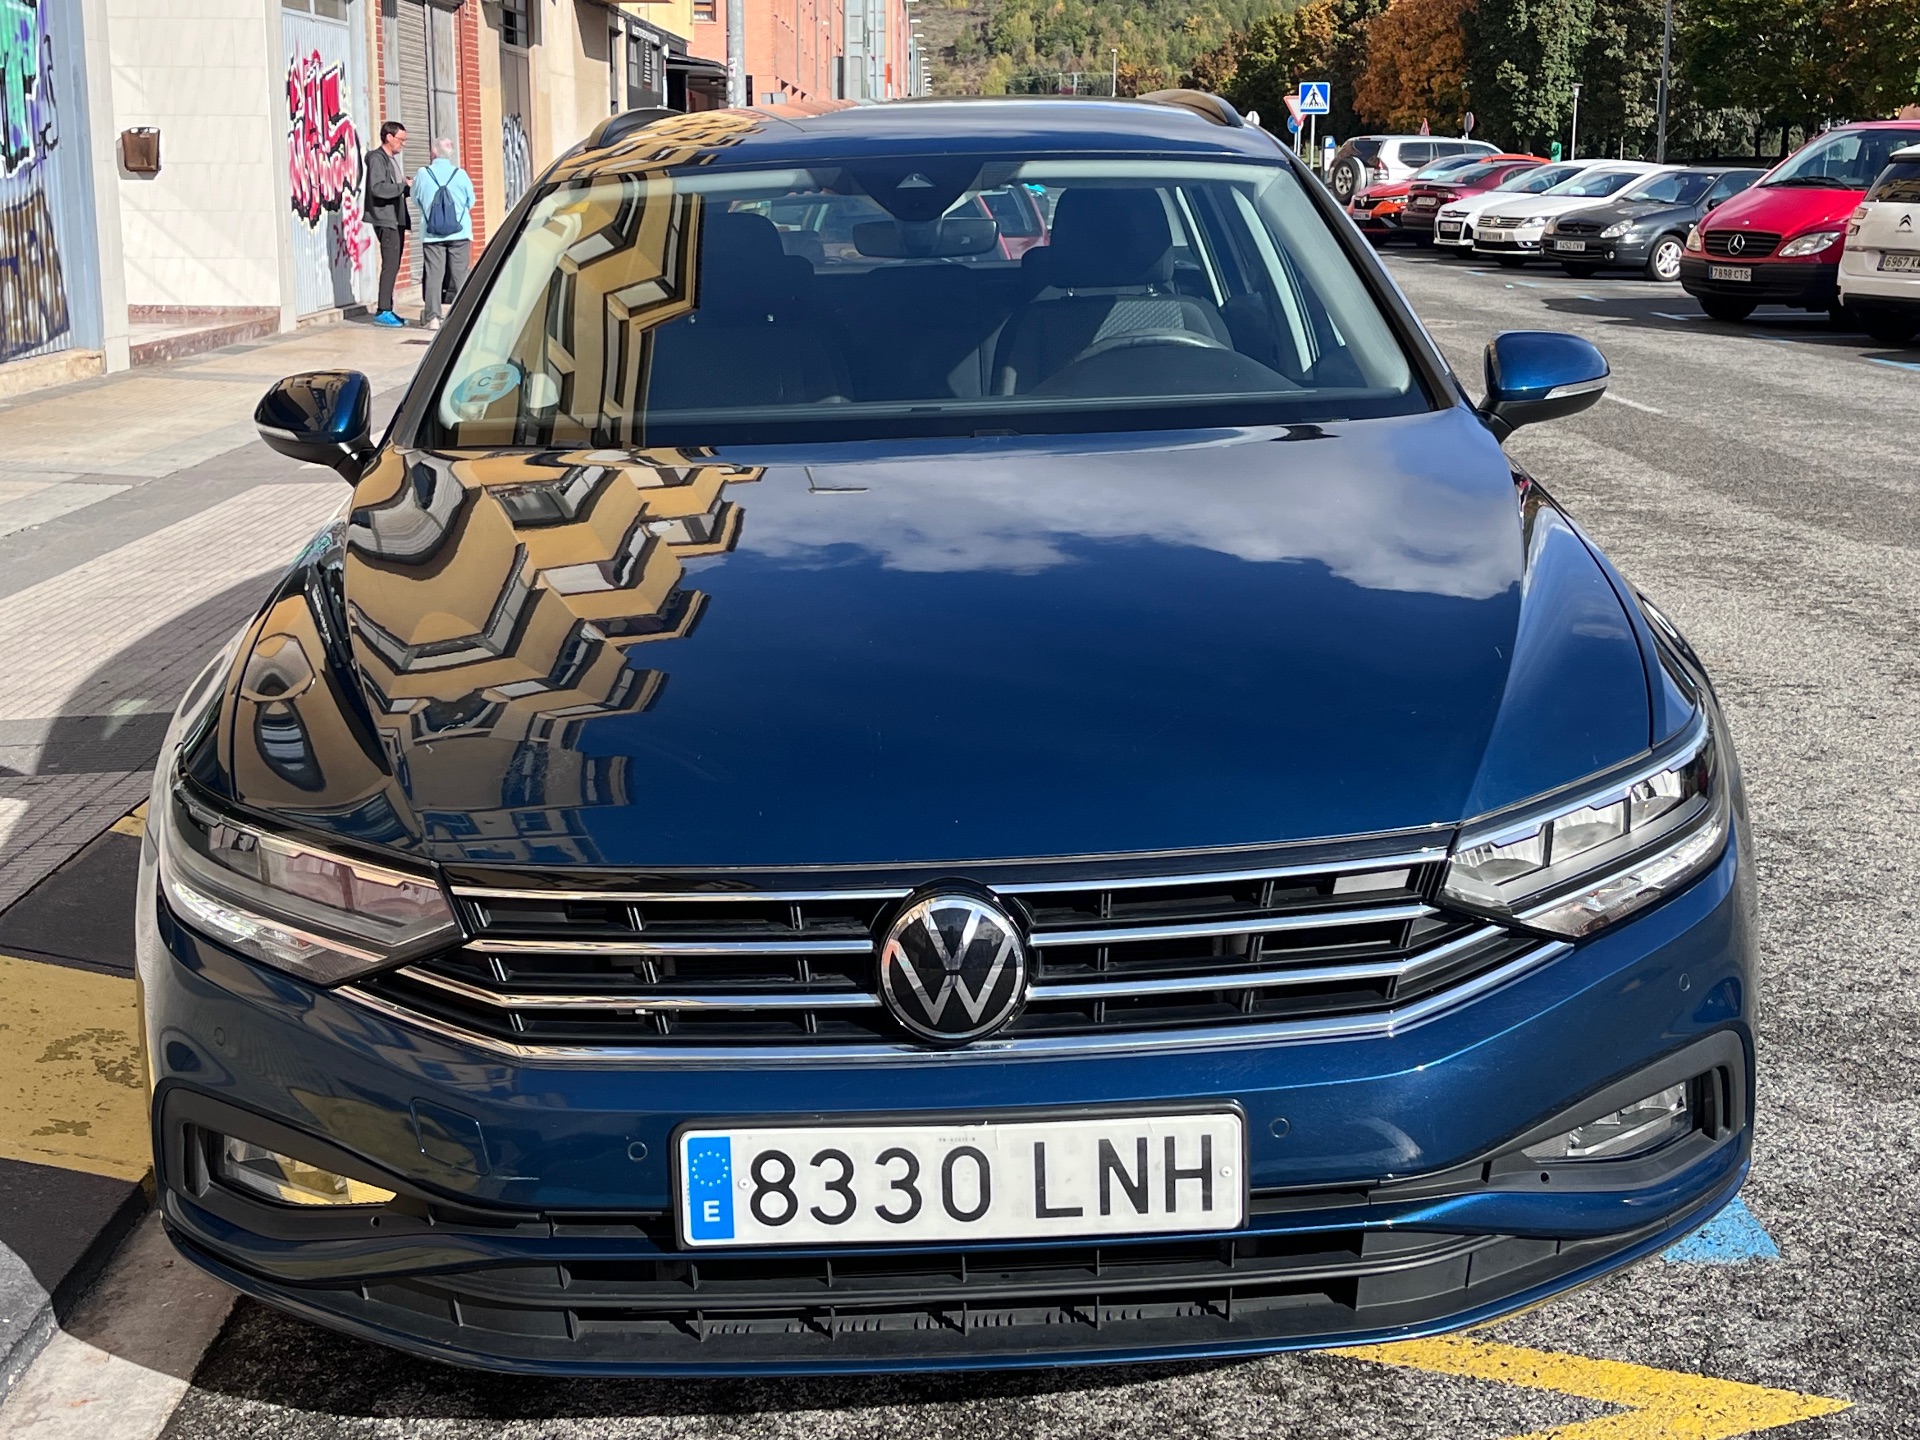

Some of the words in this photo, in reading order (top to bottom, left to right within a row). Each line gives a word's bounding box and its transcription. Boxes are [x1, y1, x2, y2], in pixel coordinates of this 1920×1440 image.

[1885, 256, 1910, 267] 6967
[1713, 267, 1733, 278] 7898
[1733, 269, 1749, 280] CTS
[703, 1200, 720, 1222] E
[750, 1146, 991, 1227] 8330
[1034, 1134, 1213, 1219] LNH
